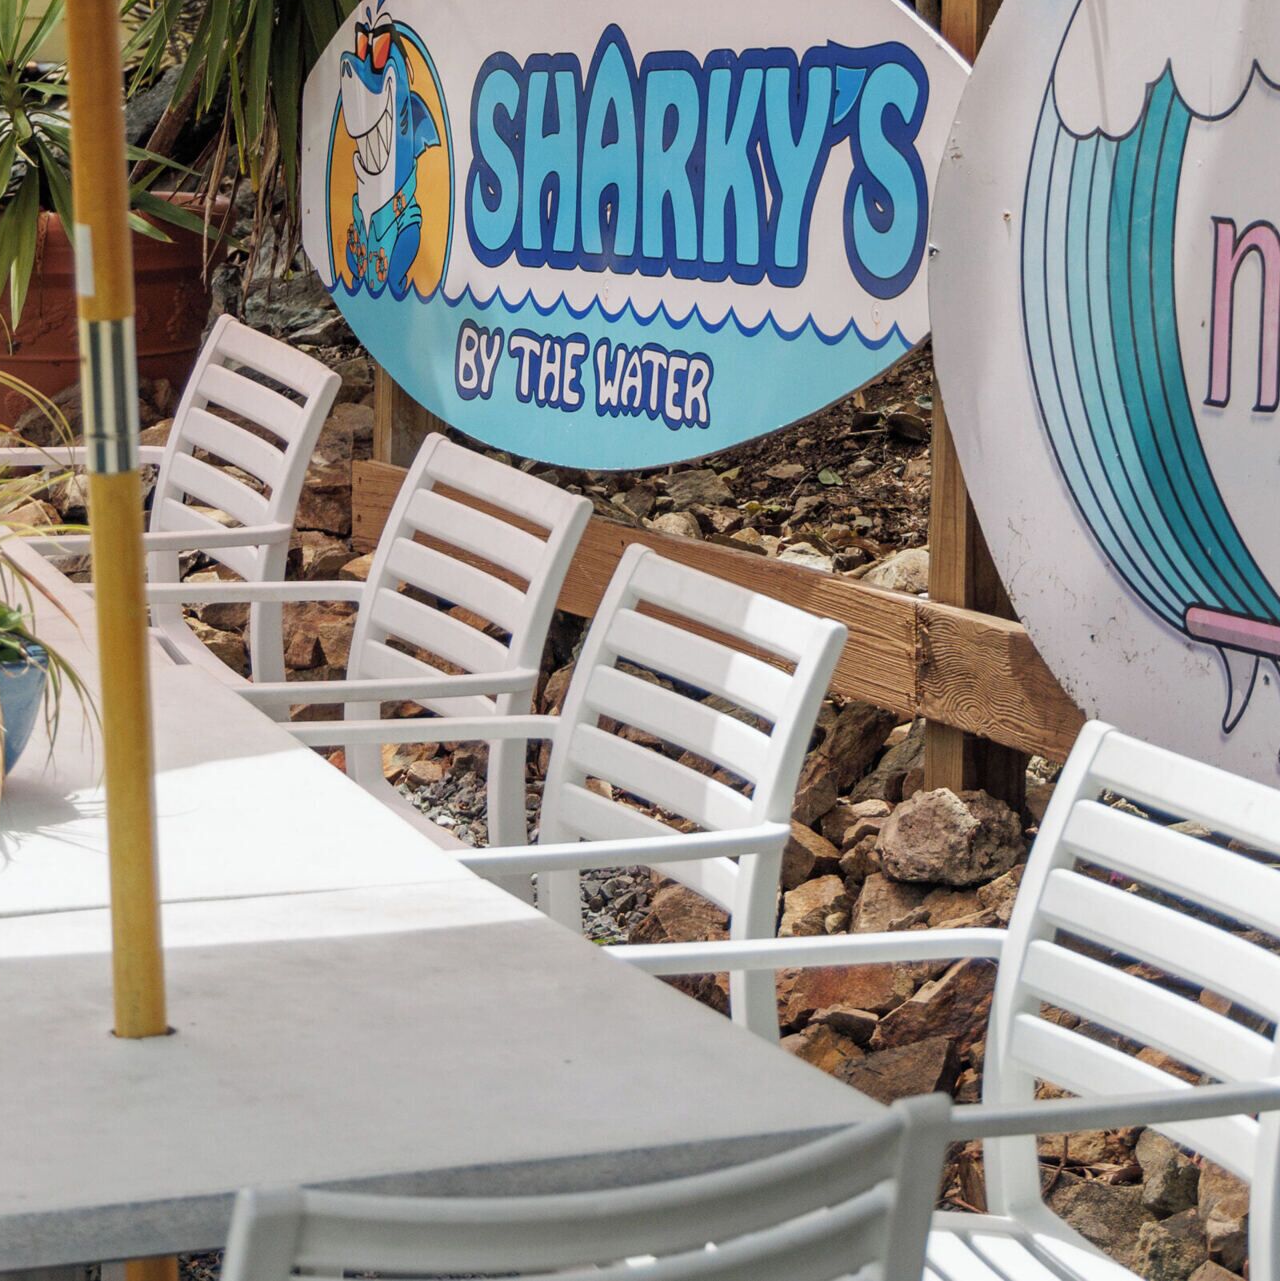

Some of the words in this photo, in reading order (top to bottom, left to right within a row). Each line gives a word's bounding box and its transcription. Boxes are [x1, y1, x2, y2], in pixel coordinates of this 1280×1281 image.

[466, 23, 930, 300] SHARKY'S
[456, 321, 503, 400] BY
[509, 331, 587, 412] THE
[594, 339, 714, 430] WATER
